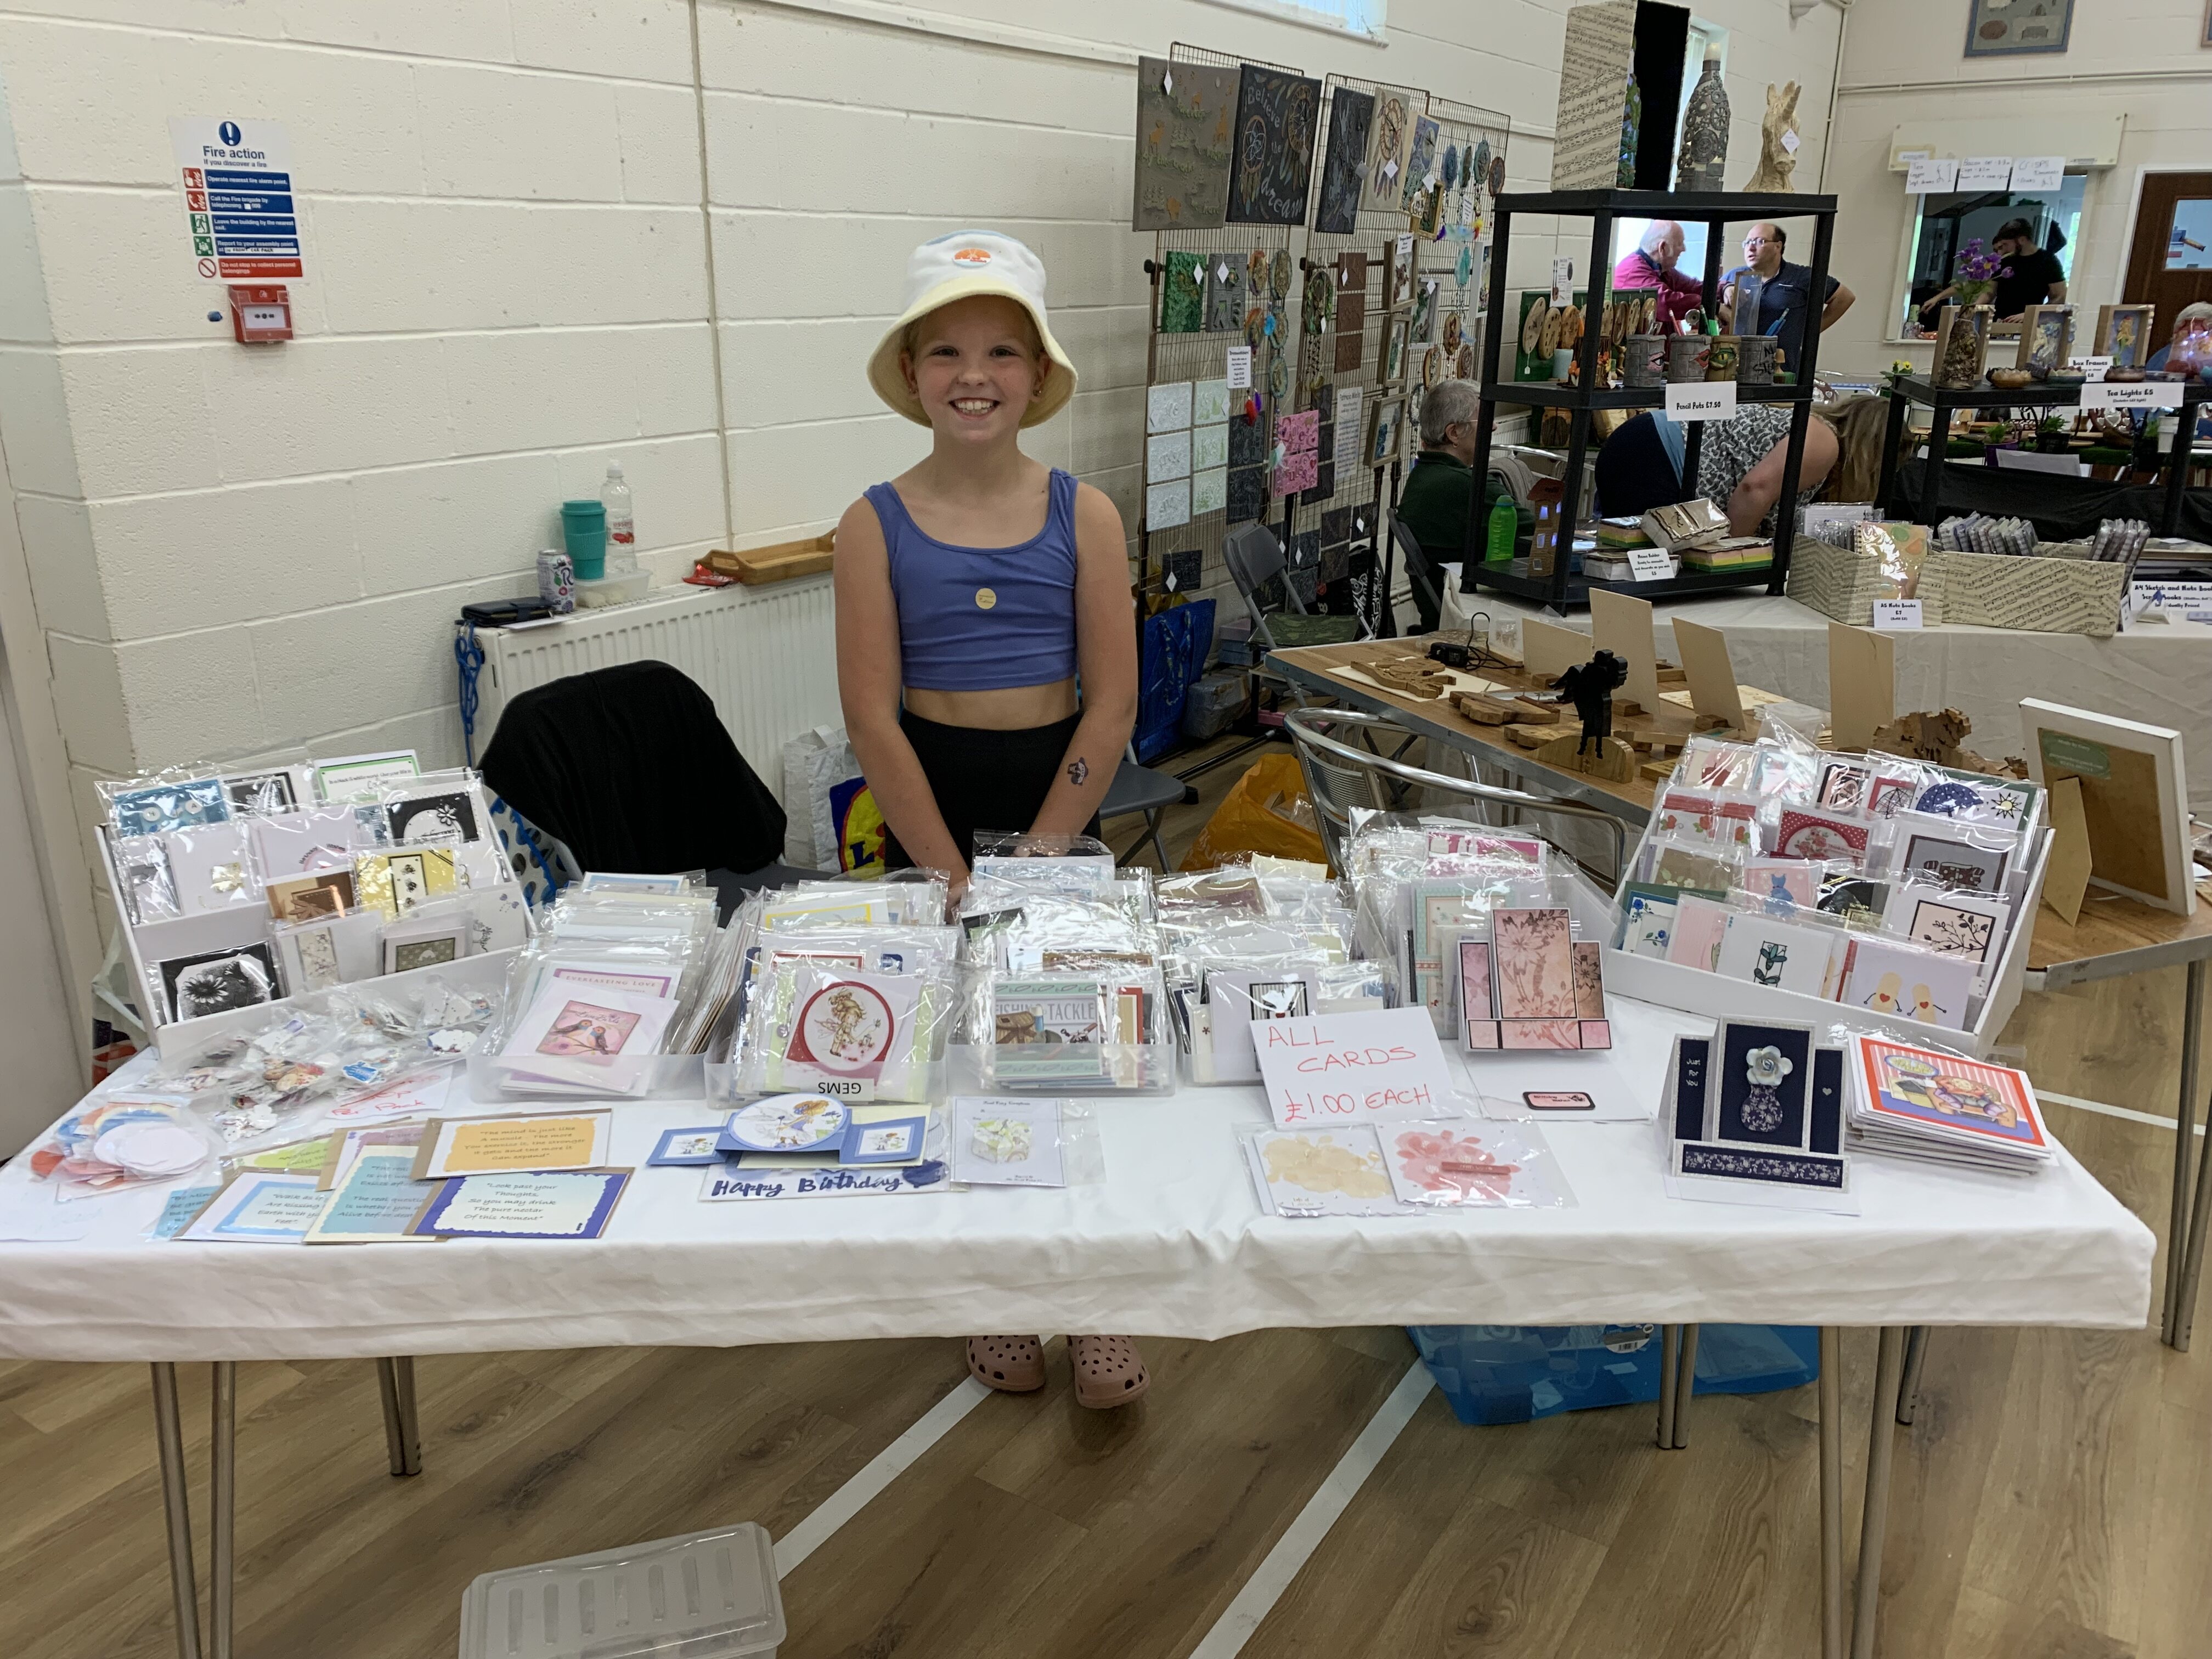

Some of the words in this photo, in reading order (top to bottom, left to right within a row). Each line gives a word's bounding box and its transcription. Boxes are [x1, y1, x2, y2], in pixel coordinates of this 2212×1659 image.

[1248, 86, 1280, 128] Believe
[203, 145, 225, 157] Fire
[229, 149, 265, 160] action
[1271, 140, 1282, 154] the
[1261, 165, 1304, 219] dream
[2120, 389, 2142, 398] Lights
[1677, 402, 1691, 410] Pencil
[566, 975, 628, 986] EVERLASTING
[1047, 1002, 1095, 1020] TACKLE
[596, 1014, 621, 1024] Birds
[1269, 1025, 1334, 1047] ALL
[1297, 1047, 1416, 1072] CARDS
[818, 1082, 861, 1094] GEMS
[375, 1099, 426, 1111] Pack
[1285, 1089, 1355, 1122] £1.00
[1365, 1084, 1431, 1109] EACH
[711, 1180, 785, 1198] Happy
[798, 1171, 904, 1193] Birthday
